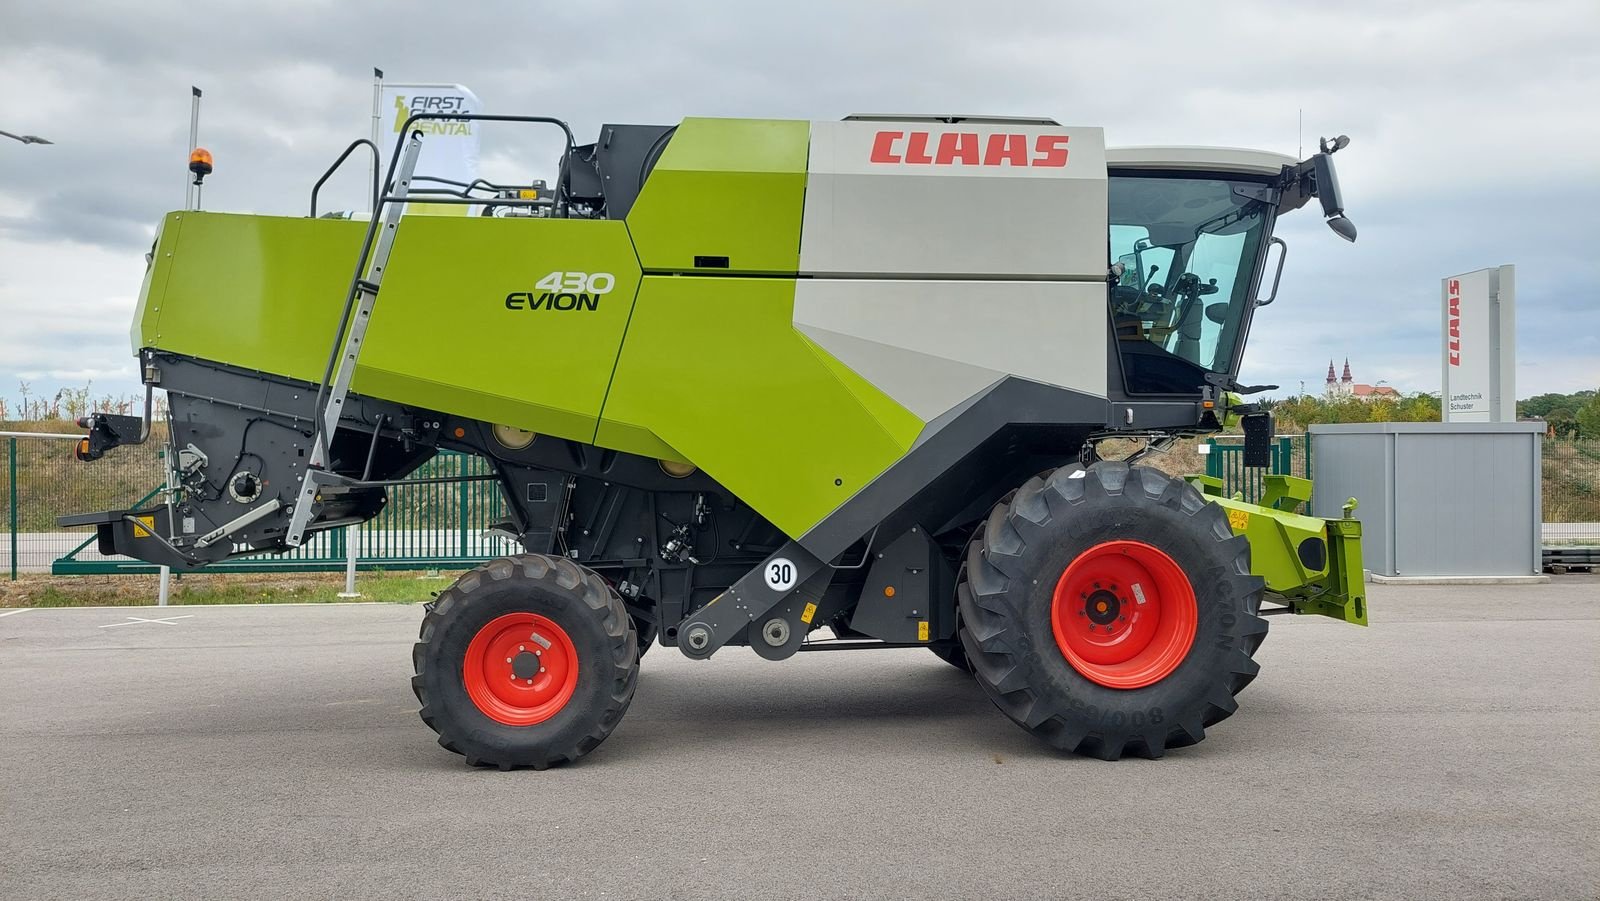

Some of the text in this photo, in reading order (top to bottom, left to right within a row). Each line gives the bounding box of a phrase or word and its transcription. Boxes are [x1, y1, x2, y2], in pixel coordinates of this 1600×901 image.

[411, 96, 464, 109] FIRST
[870, 131, 1070, 167] CLAAS
[535, 271, 615, 294] 430
[505, 292, 601, 311] EVION
[1449, 279, 1460, 366] CLAAS
[1450, 393, 1482, 401] Landtechnik
[1450, 402, 1474, 410] Schuster
[771, 564, 791, 584] 30
